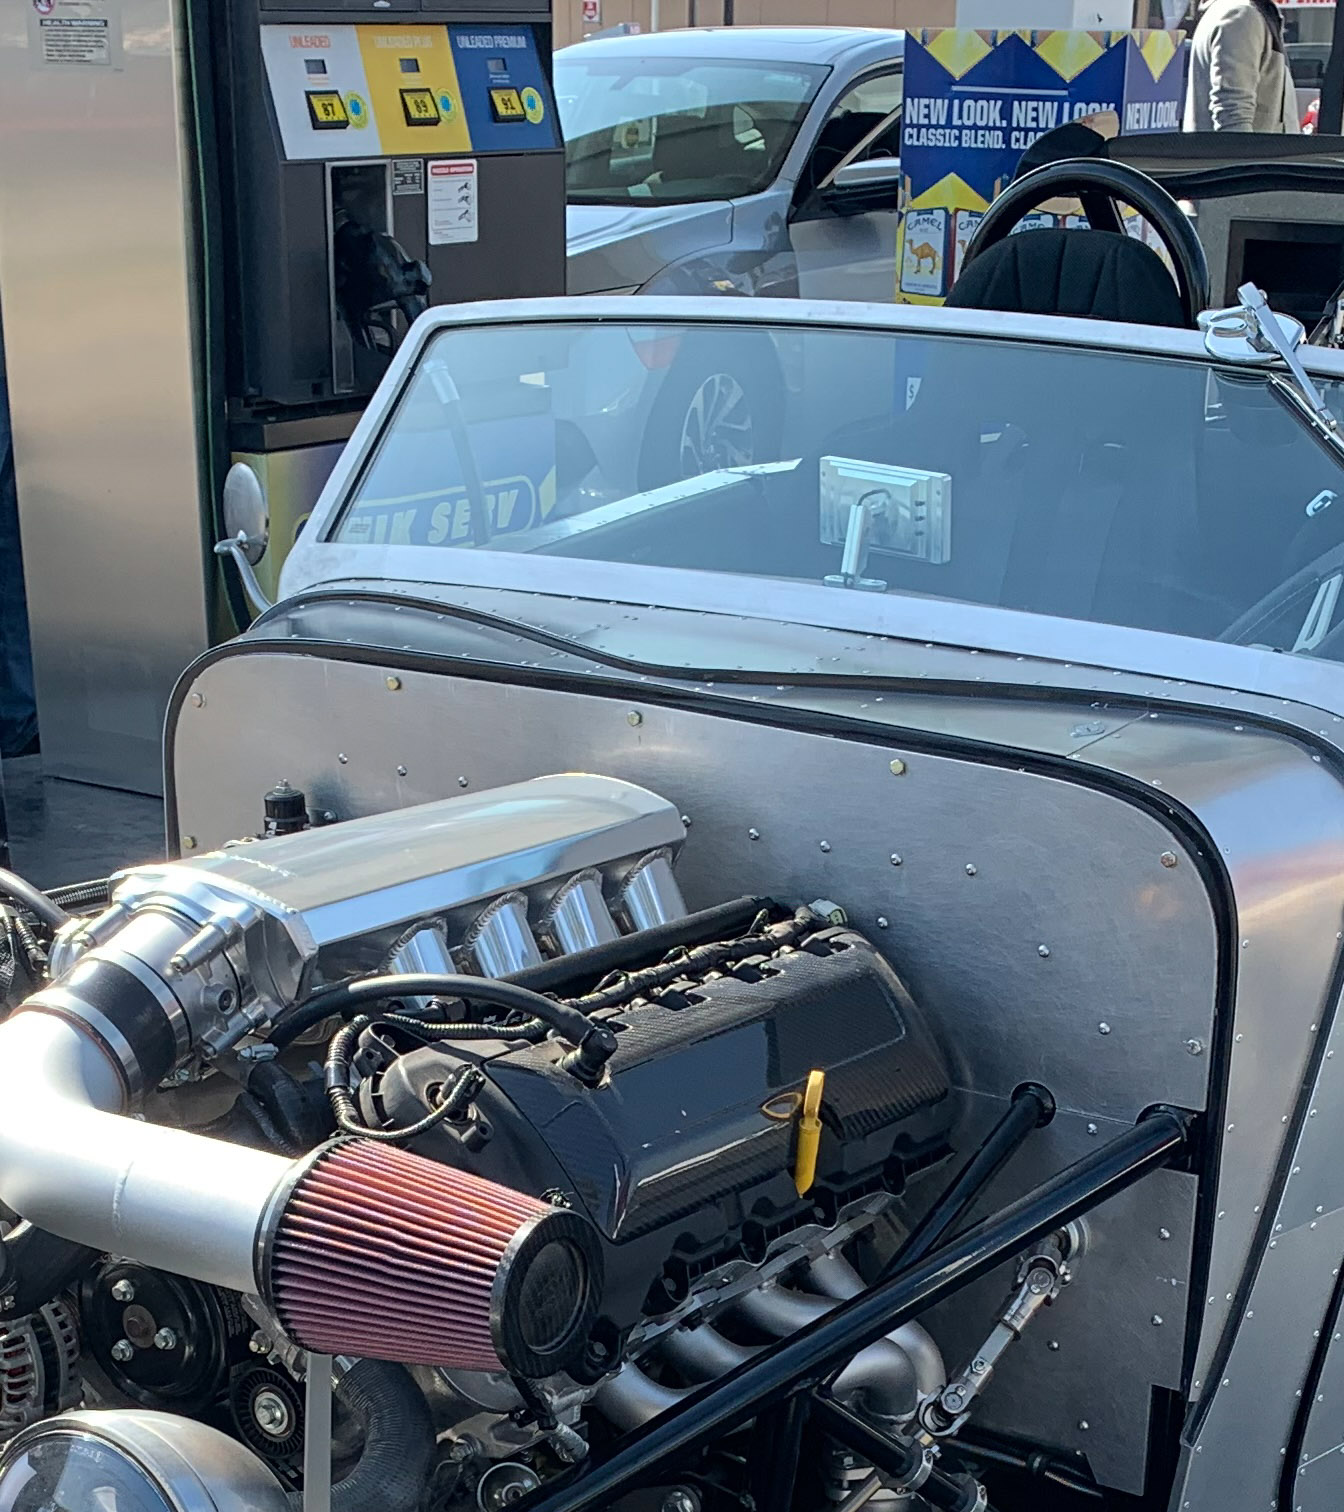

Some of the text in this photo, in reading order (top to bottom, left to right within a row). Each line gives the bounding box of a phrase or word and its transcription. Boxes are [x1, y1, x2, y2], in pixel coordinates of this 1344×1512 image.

[906, 97, 1007, 128] NEW LOOK.
[1012, 100, 1057, 129] NEW
[1127, 101, 1180, 130] NEW LOOK.
[904, 127, 959, 148] CLASSIC
[961, 129, 1006, 149] BLEND.
[907, 216, 943, 231] CAMEL
